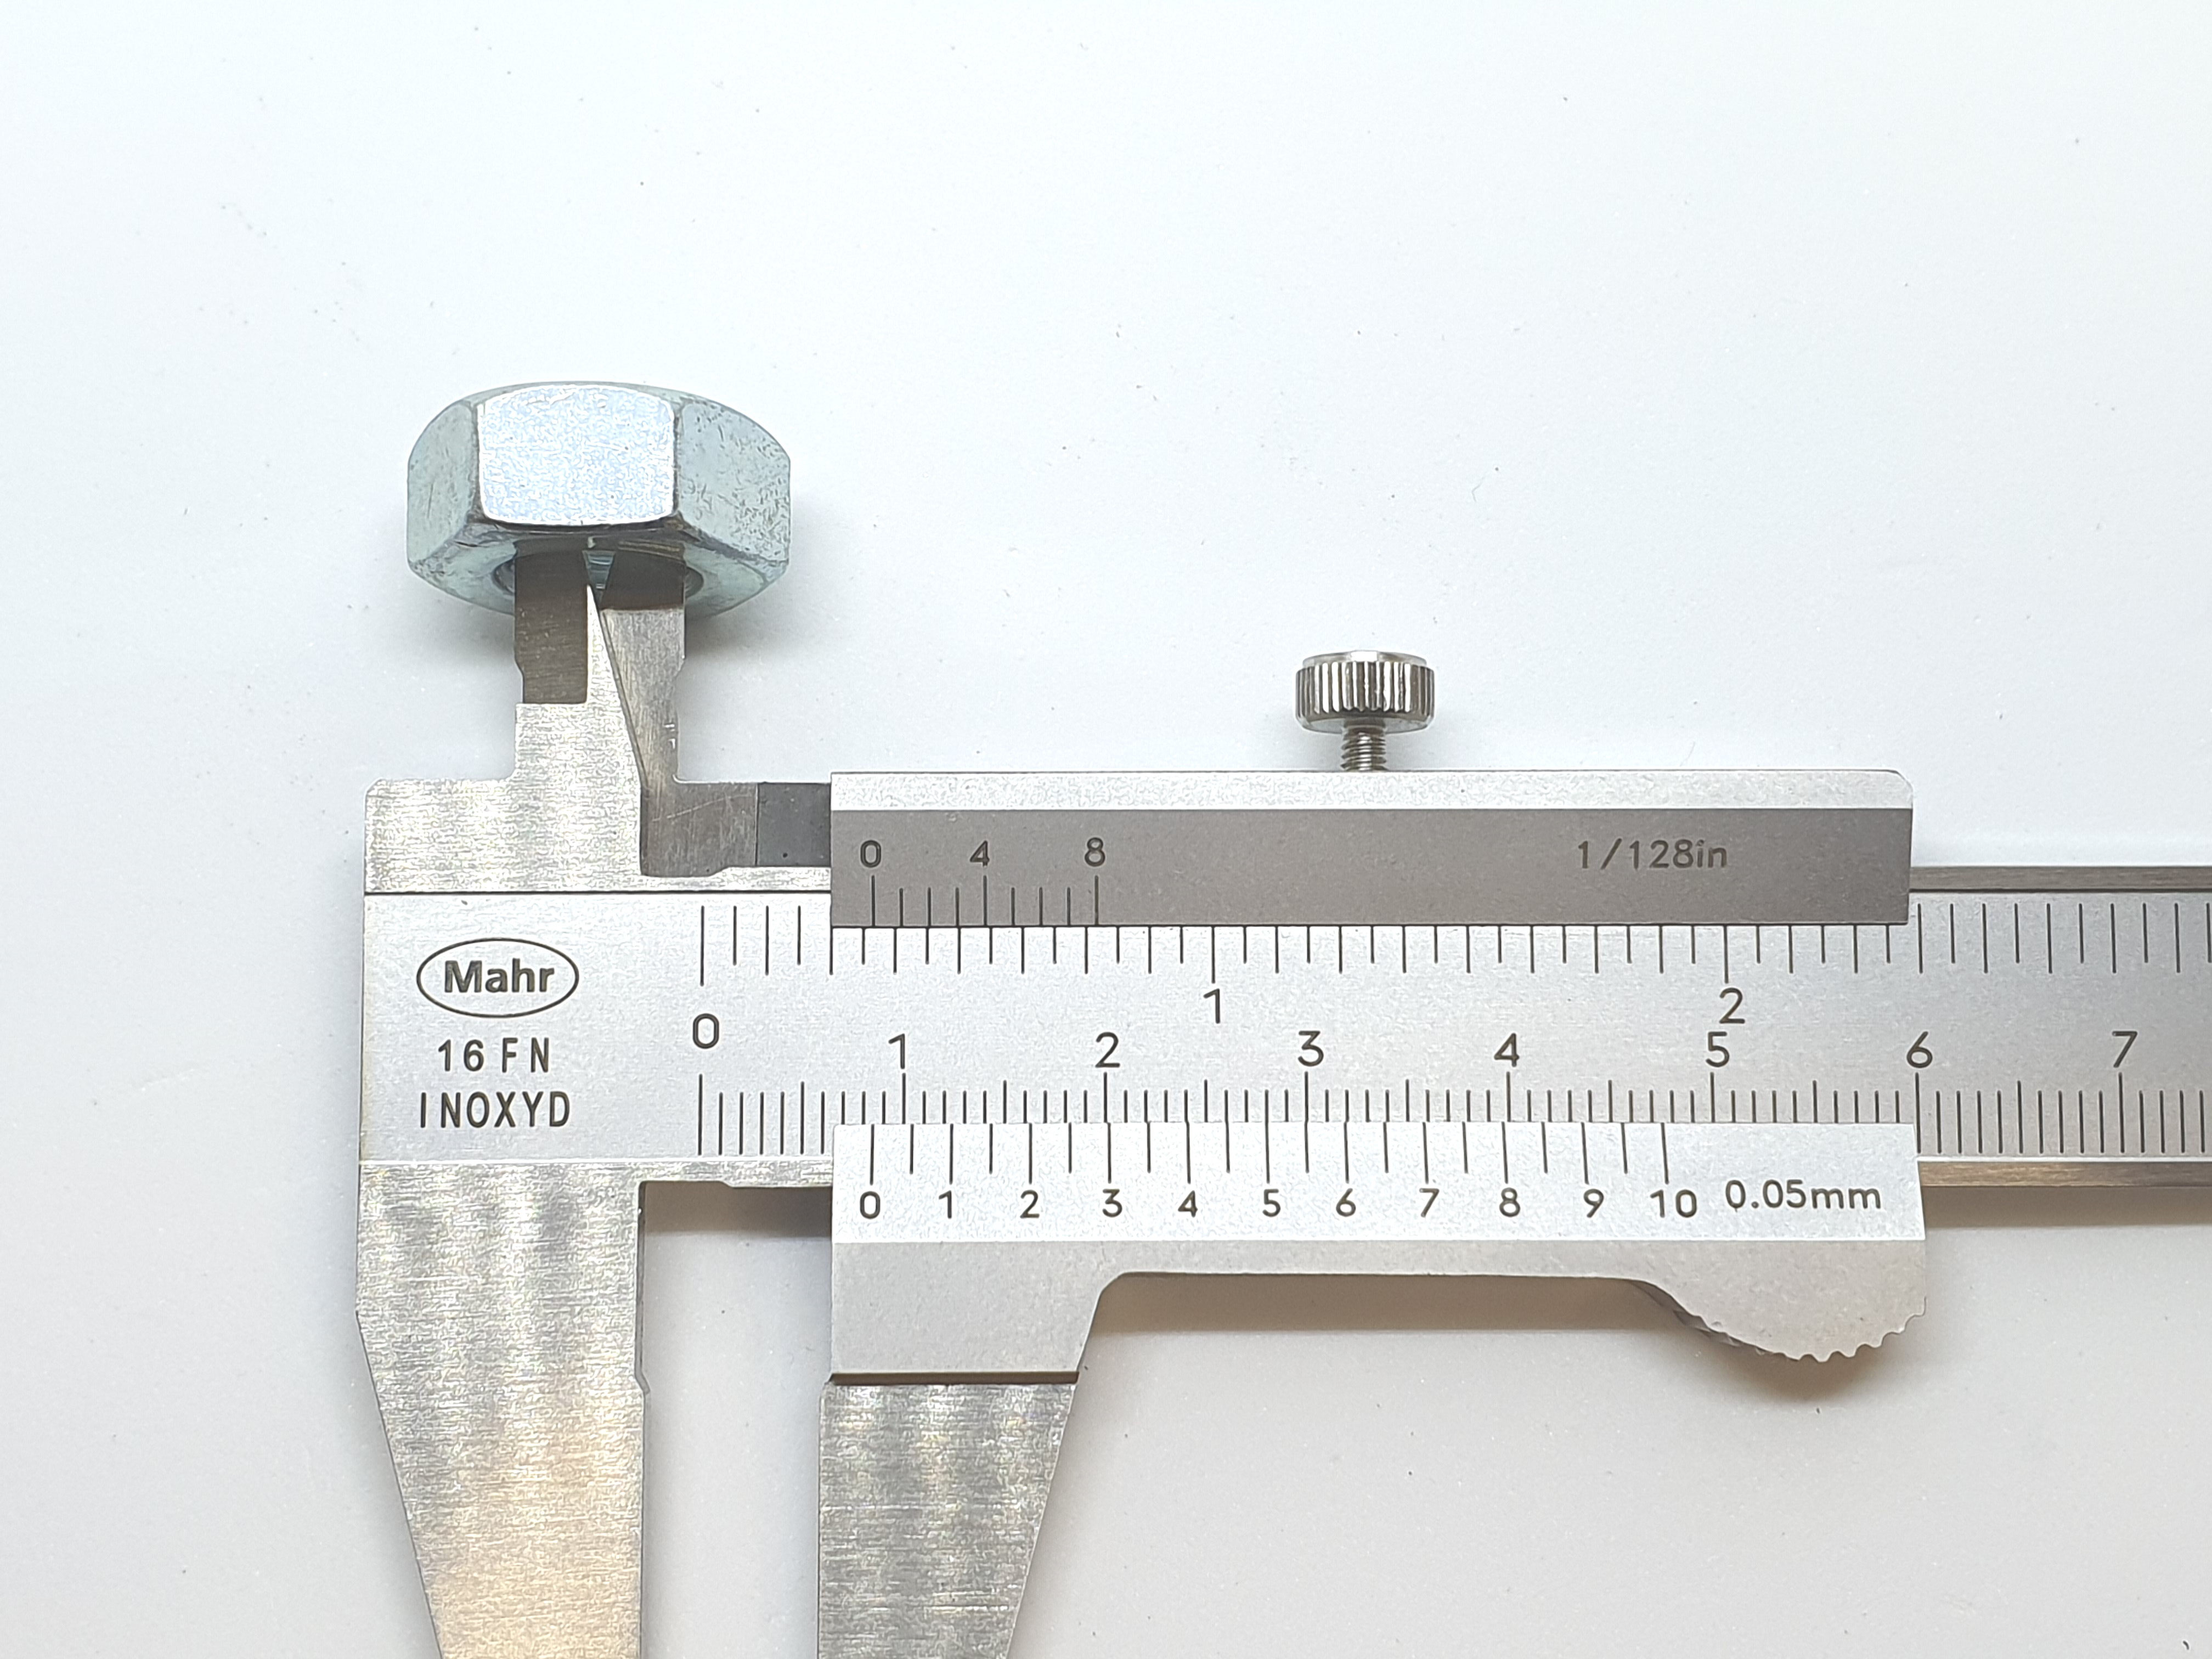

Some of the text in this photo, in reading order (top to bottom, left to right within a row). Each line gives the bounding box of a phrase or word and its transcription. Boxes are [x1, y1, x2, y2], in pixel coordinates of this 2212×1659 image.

[860, 837, 1727, 869] 0 4 8 1/128in
[444, 957, 555, 994] Mahr
[1203, 987, 1746, 1024] 1 2
[438, 1037, 549, 1073] 16 FN
[692, 1013, 2138, 1070] 0 1 2 3 4 5 6 7
[420, 1091, 570, 1128] INOXYD
[860, 1179, 1881, 1220] 0 1 2 3 4 5 6 7 8 9 10 0.05mm
